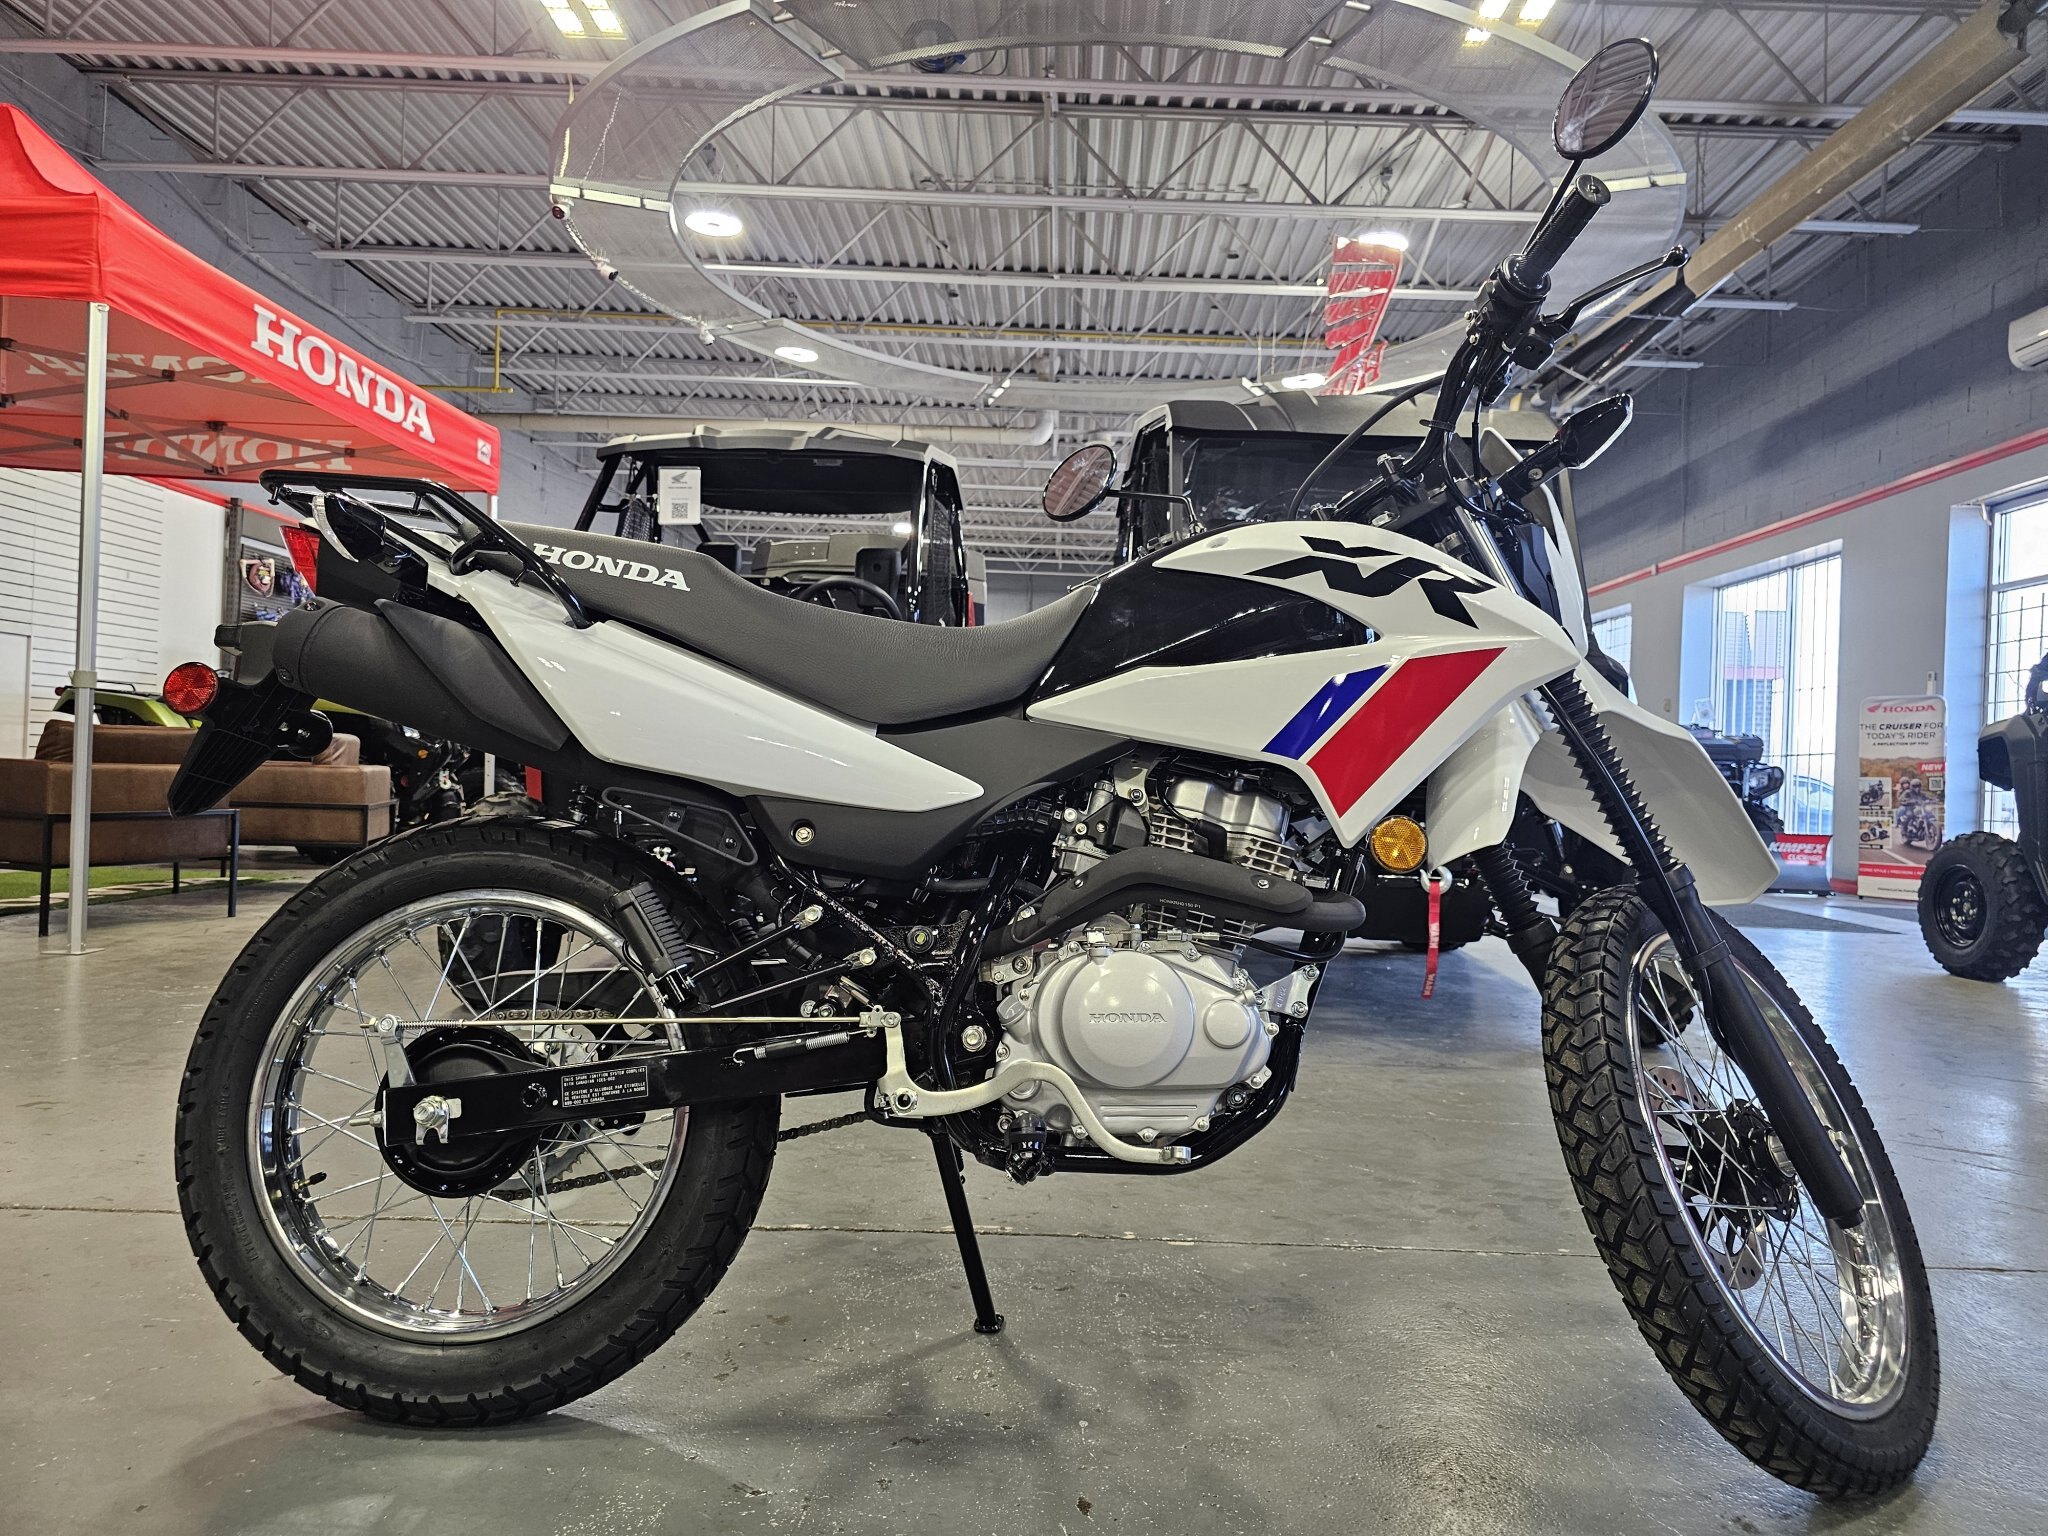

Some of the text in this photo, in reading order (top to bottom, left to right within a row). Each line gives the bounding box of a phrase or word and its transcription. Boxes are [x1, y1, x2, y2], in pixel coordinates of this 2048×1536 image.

[251, 303, 435, 444] HONDA
[533, 543, 690, 592] HONDA
[1883, 704, 1936, 713] HONDA
[1860, 721, 1944, 731] THE CRUISER FOR
[1866, 731, 1936, 740] TODAY'S RIDER
[1920, 763, 1943, 771] NEW
[1768, 841, 1827, 854] KIMPEX
[1089, 1012, 1168, 1023] HONDA
